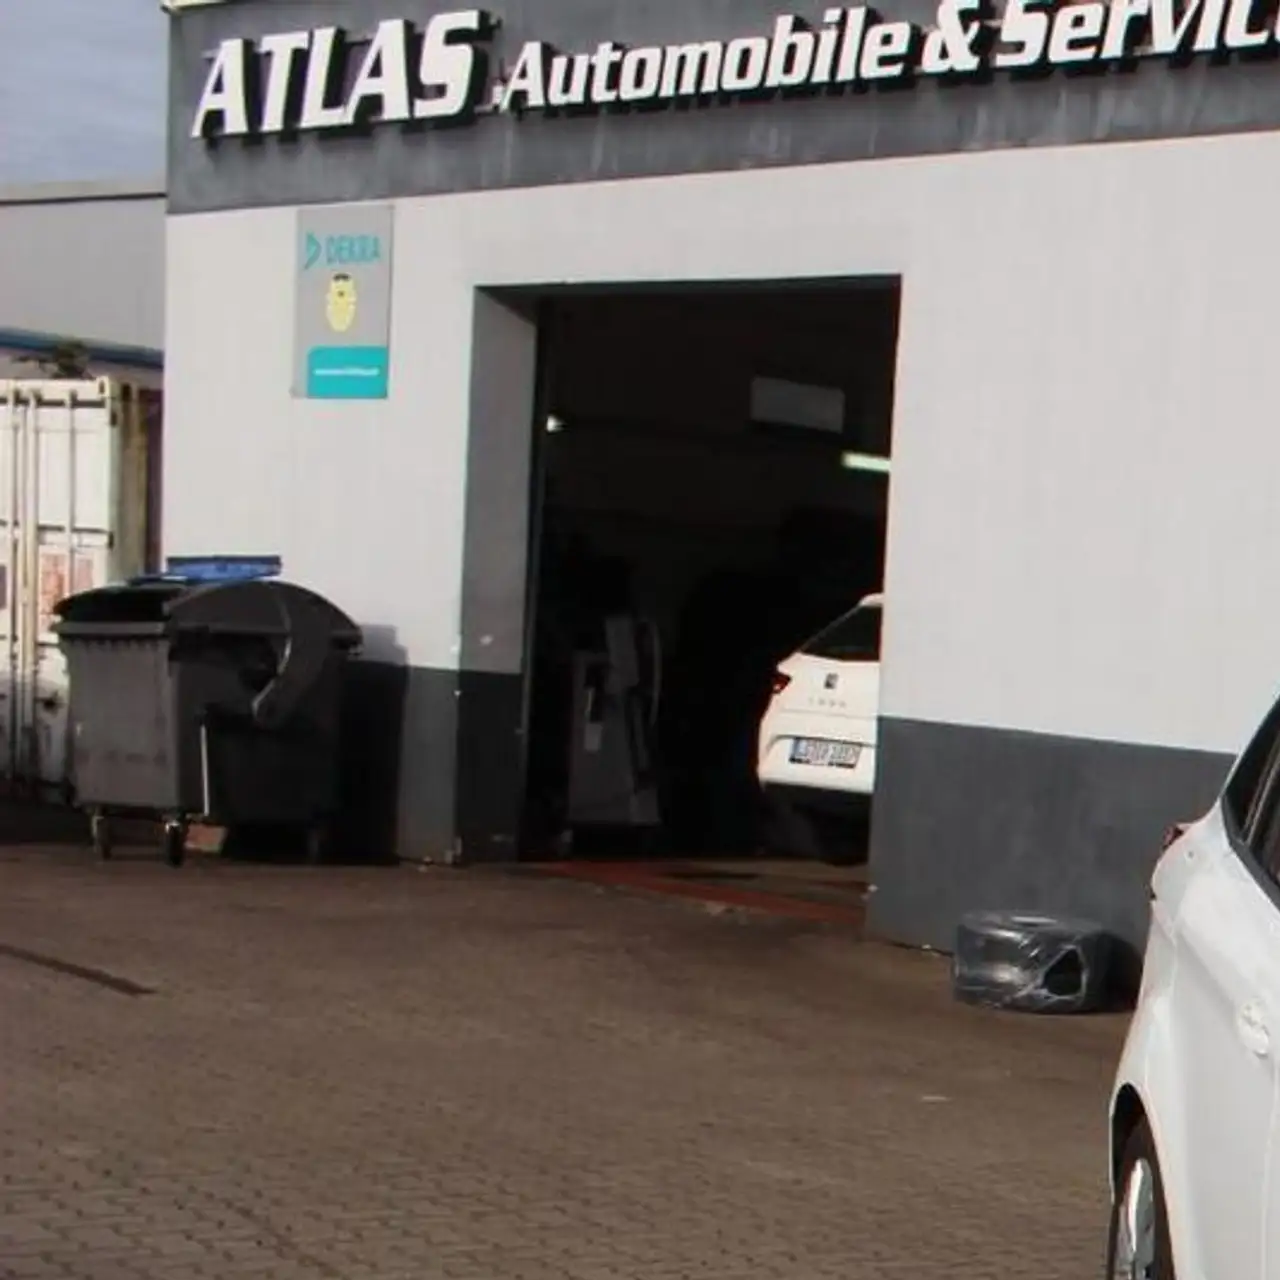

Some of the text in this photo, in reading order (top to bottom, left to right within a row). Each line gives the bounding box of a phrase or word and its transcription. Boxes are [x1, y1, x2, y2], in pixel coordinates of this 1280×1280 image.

[190, 9, 479, 138] ATLAS
[500, 5, 910, 108] Automobile
[921, 0, 981, 73] &
